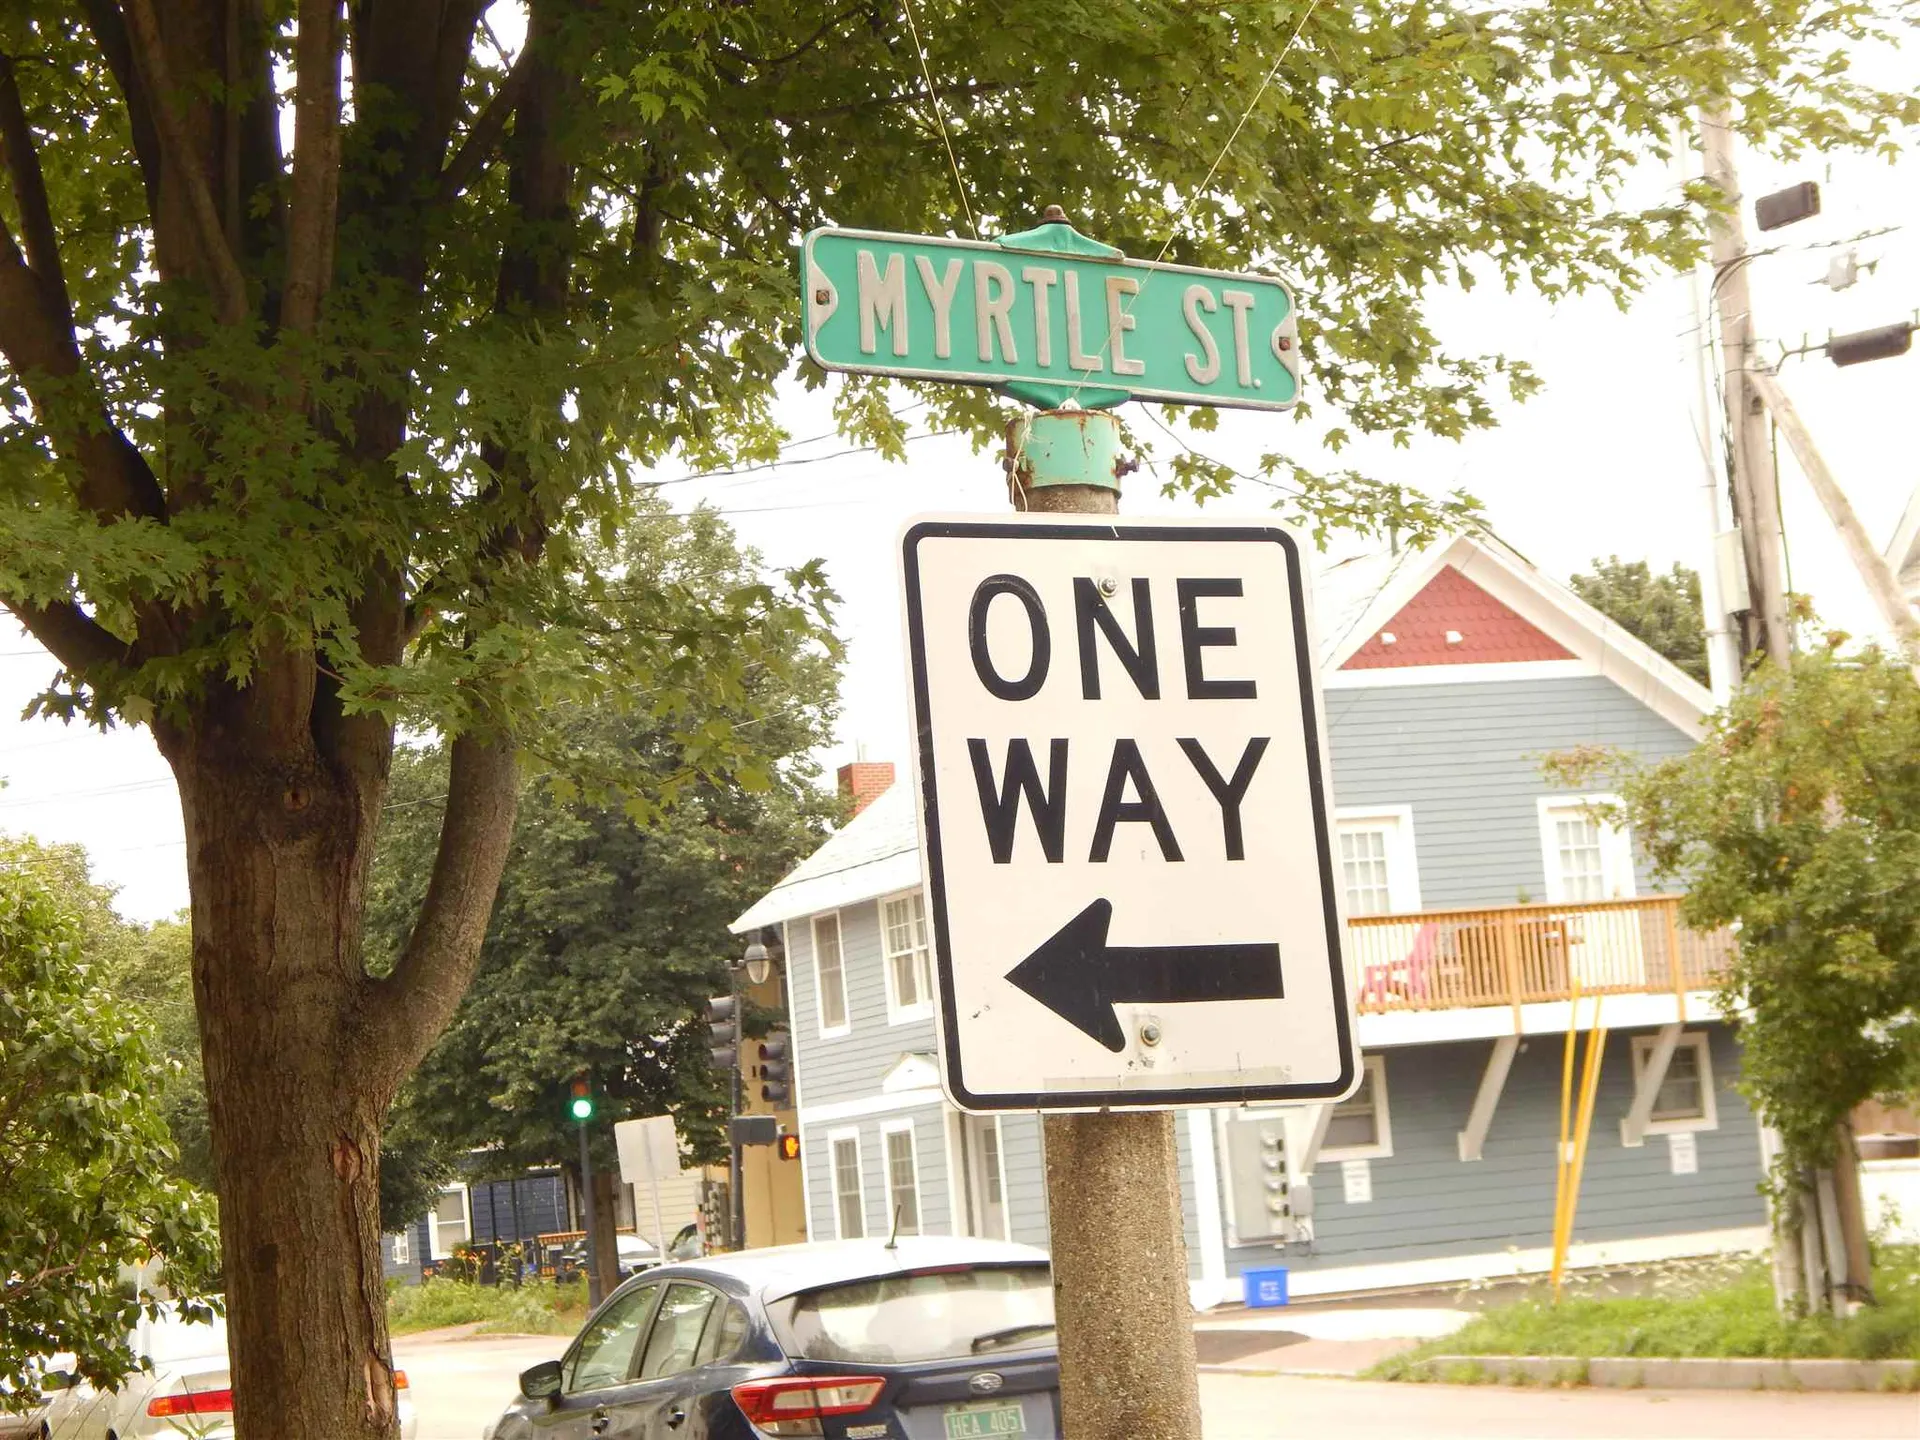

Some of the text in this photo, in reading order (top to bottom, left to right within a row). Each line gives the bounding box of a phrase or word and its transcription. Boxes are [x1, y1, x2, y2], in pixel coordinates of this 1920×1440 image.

[856, 249, 1262, 389] MYRTLE ST.
[968, 573, 1258, 701] ONE
[966, 737, 1271, 864] WAY
